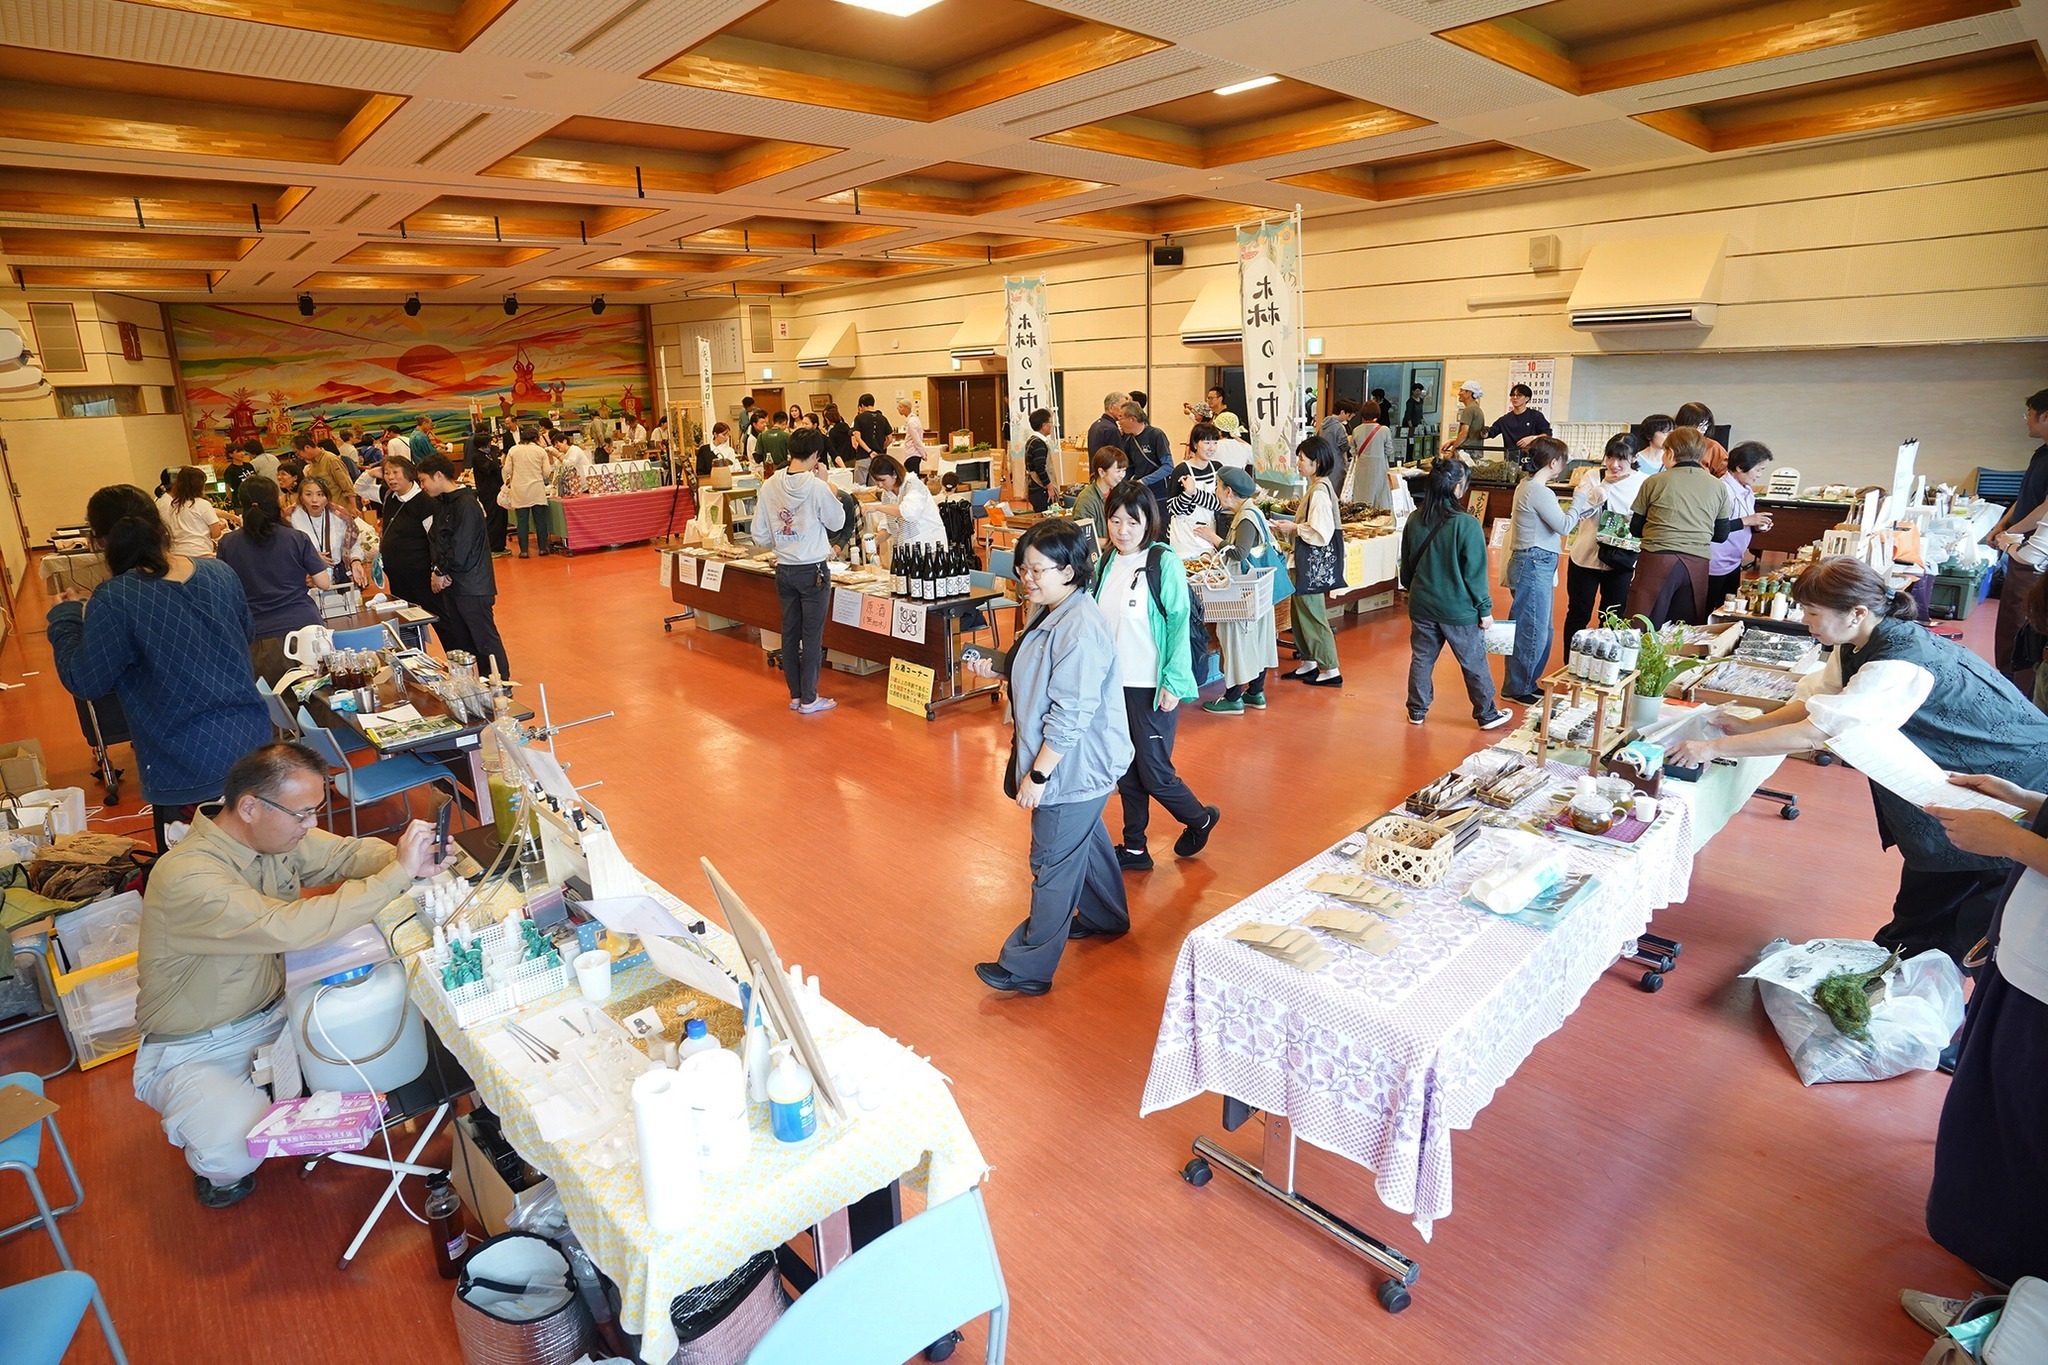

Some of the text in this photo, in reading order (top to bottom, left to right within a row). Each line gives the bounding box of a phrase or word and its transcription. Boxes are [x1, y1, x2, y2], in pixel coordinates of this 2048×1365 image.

[1528, 361, 1537, 371] 10
[865, 601, 886, 617] 原酒
[894, 663, 929, 678] お酒コーナー
